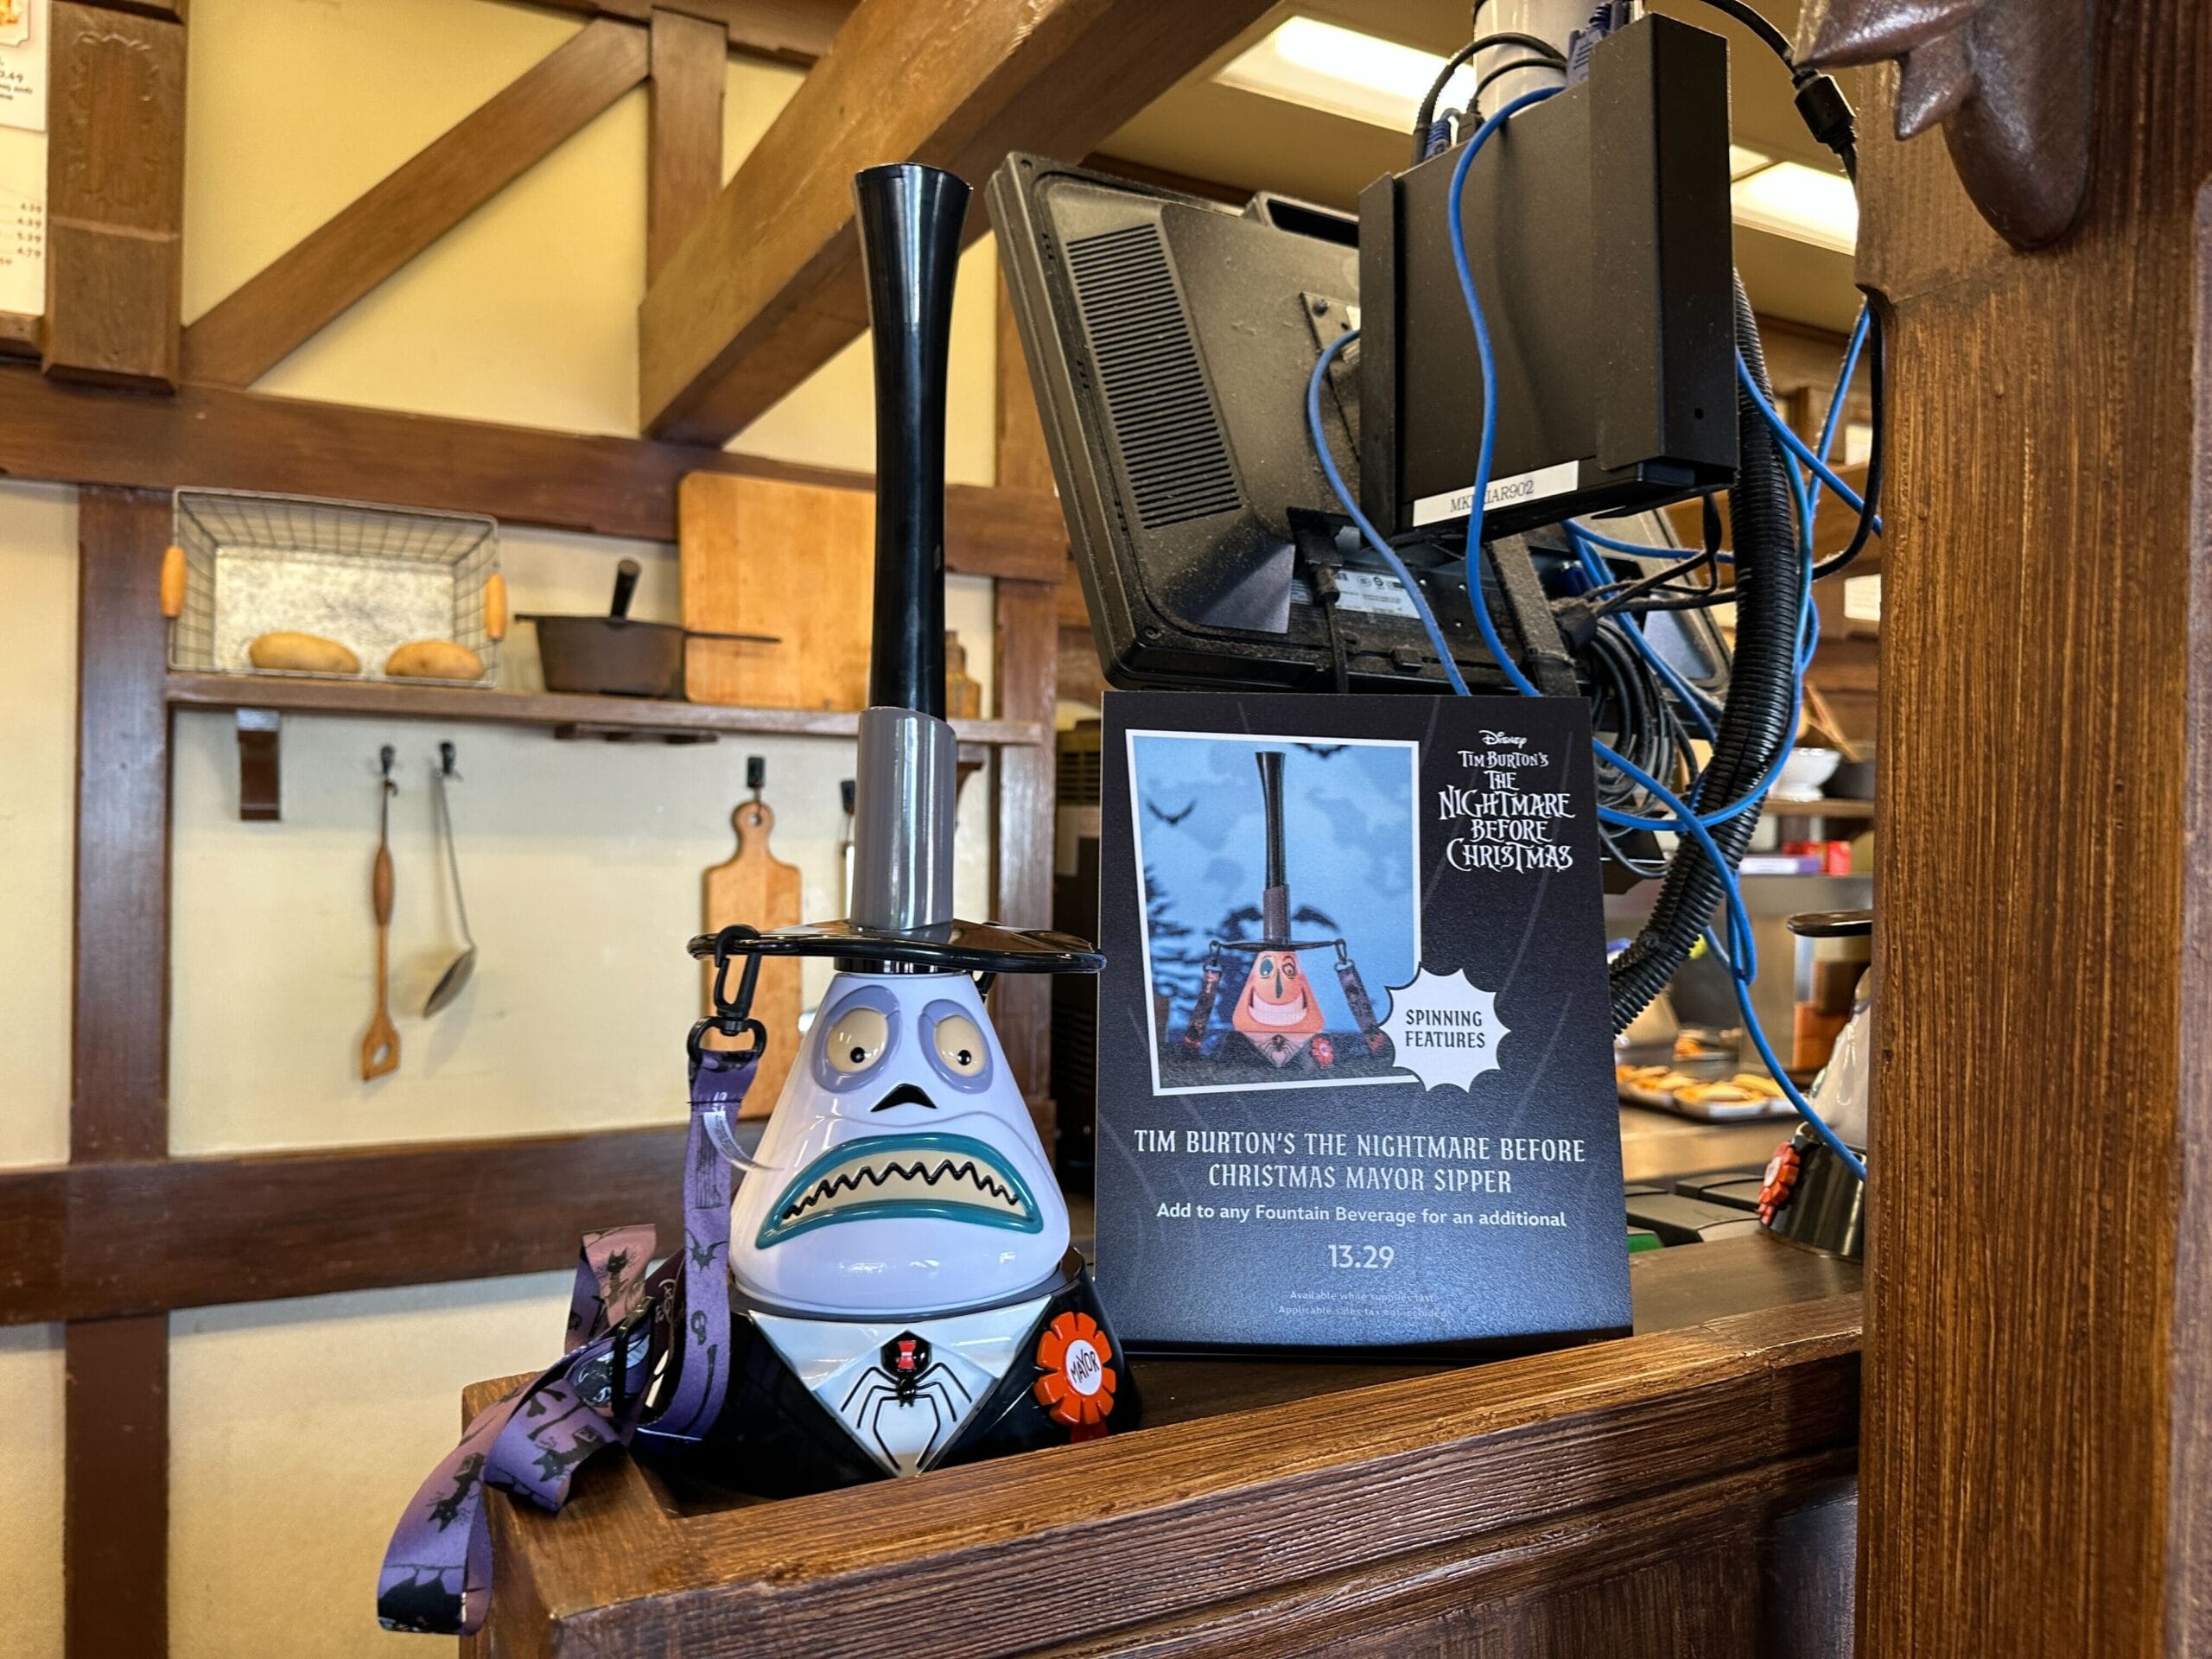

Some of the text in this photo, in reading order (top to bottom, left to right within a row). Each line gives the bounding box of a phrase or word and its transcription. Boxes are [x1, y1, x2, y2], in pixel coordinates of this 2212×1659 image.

[1478, 730, 1527, 748] Disney
[1457, 750, 1549, 768] TIM BURTON'S
[1483, 770, 1520, 791] THE
[1438, 785, 1576, 820] NIGHTMARE
[1470, 819, 1553, 844] BEFORE
[1446, 837, 1574, 874] CHRISTMAS
[1405, 1009, 1482, 1027] SPINNING
[1405, 1031, 1485, 1048] FEATURES
[1134, 1129, 1586, 1162] TIM BURTON'S THE NIGHTMARE BEFORE
[1209, 1163, 1512, 1192] CHRISTMAS MAYOR SIPPER
[1156, 1203, 1567, 1227] Add to any Fountain Beverage for an additional
[1328, 1244, 1395, 1268] 13.29
[1290, 1291, 1336, 1300] Available
[1339, 1292, 1368, 1301] while
[1278, 1306, 1332, 1316] Applicable
[1071, 1349, 1100, 1383] MAYOR
